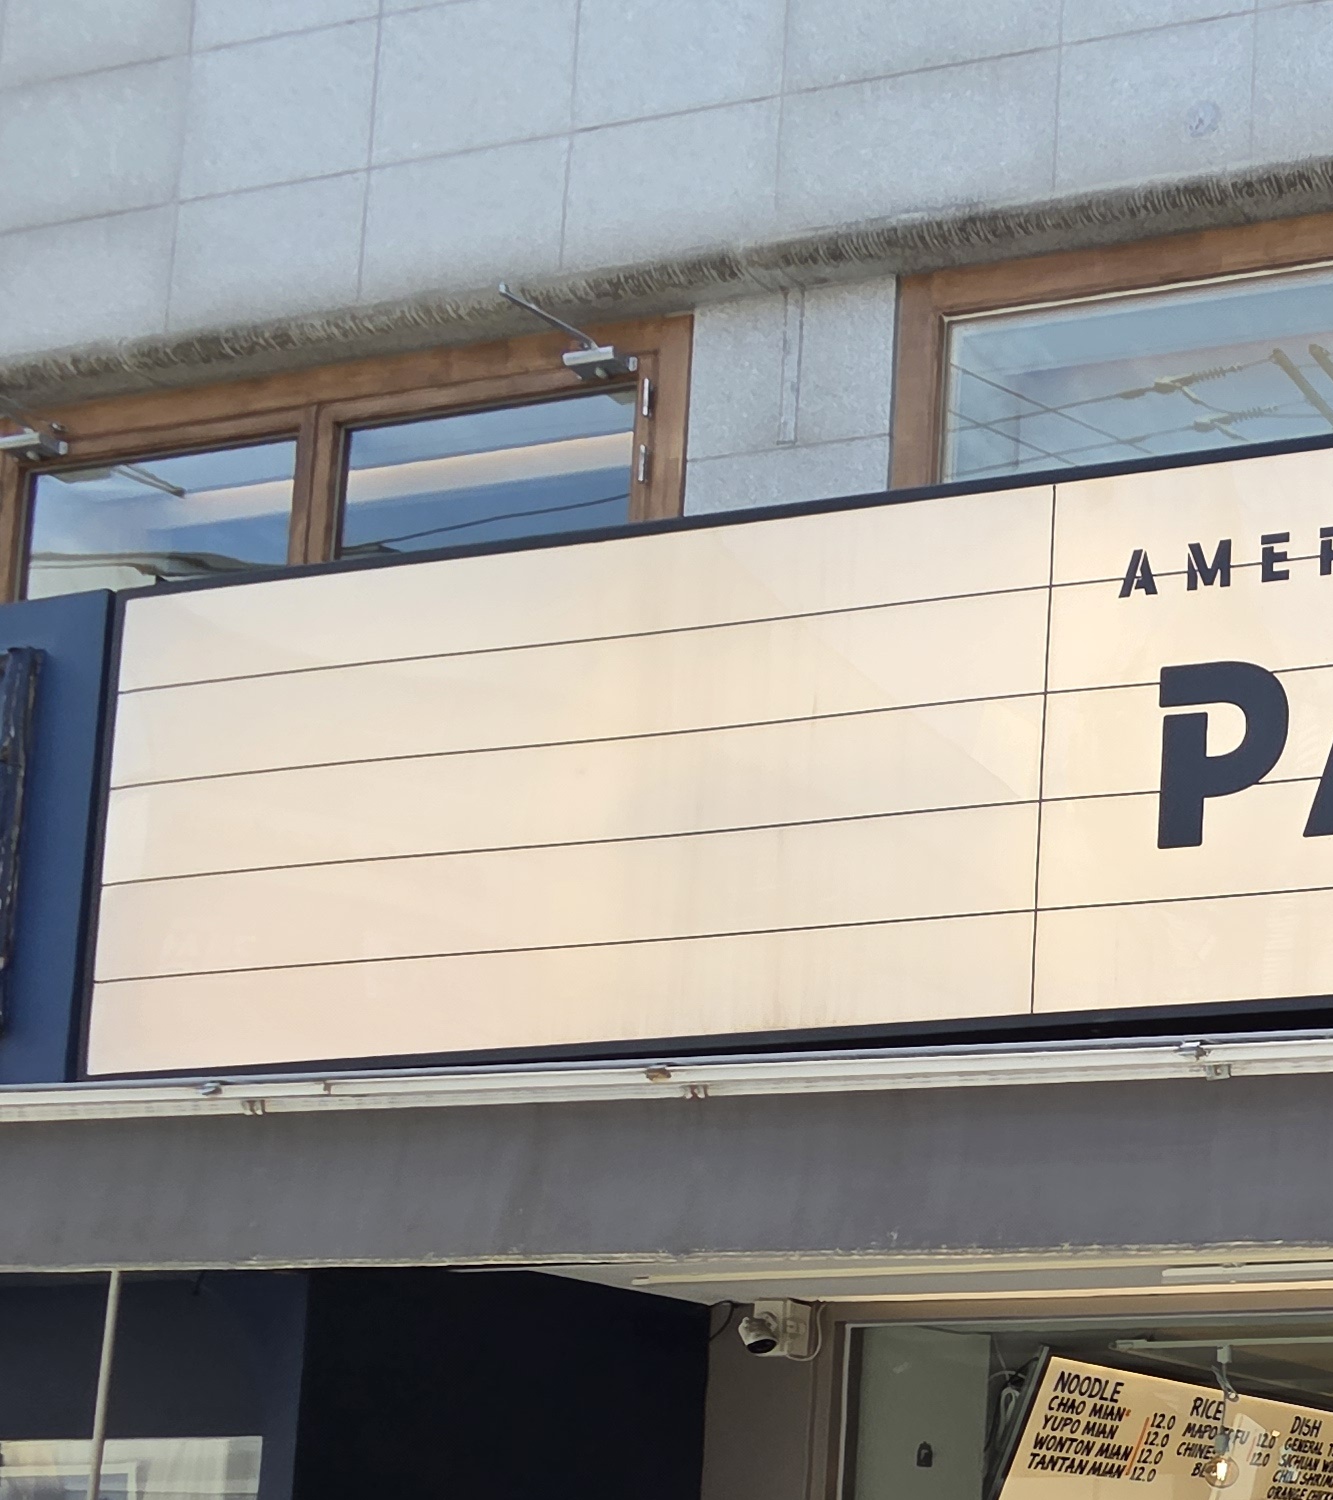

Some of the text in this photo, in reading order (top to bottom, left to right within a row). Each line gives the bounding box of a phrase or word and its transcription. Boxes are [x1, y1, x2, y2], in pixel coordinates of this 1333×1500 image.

[1053, 1370, 1125, 1403] NOODLE
[1048, 1395, 1176, 1430] CHAO MIAN 12.0
[1190, 1397, 1225, 1421] RICE
[1042, 1414, 1170, 1447] YUPO MIAN 12.0
[1182, 1422, 1218, 1440] MAPO
[1290, 1416, 1322, 1438] DISH
[1033, 1432, 1164, 1465] WONTON MIAN 12.0
[1284, 1437, 1324, 1455] GENERAL
[1027, 1452, 1156, 1482] TANTAN MIAN 12.0
[1278, 1454, 1320, 1472] SICHUAN
